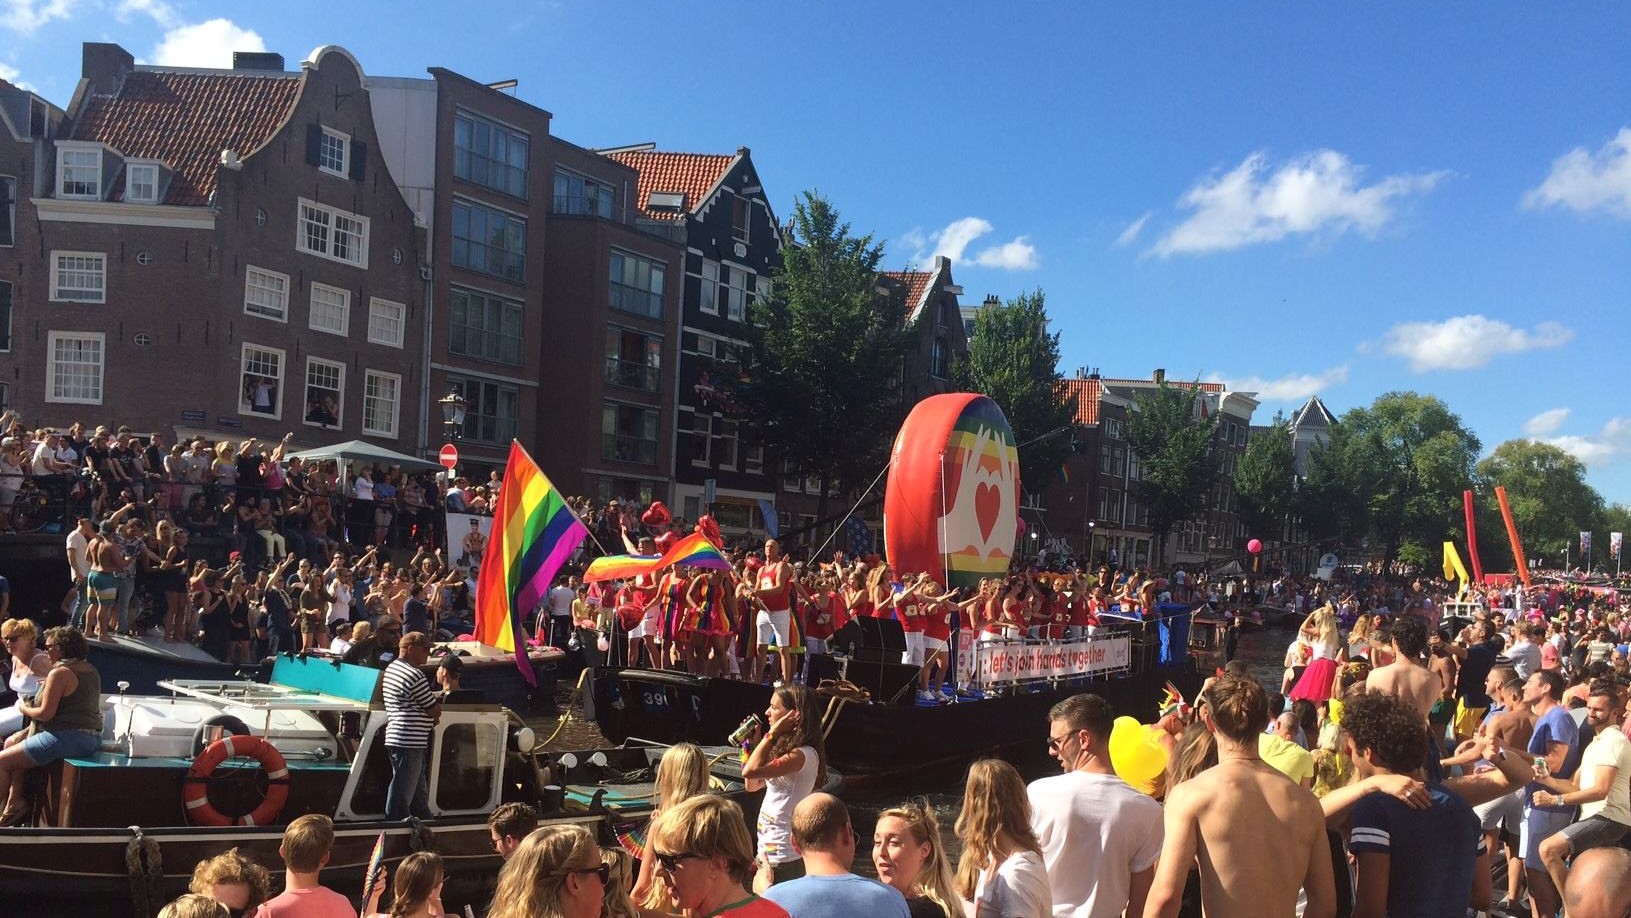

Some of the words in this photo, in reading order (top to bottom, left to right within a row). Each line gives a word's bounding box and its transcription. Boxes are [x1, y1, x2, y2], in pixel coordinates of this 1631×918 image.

[989, 651, 1013, 674] let's
[1014, 649, 1034, 675] join
[1036, 648, 1066, 669] hands
